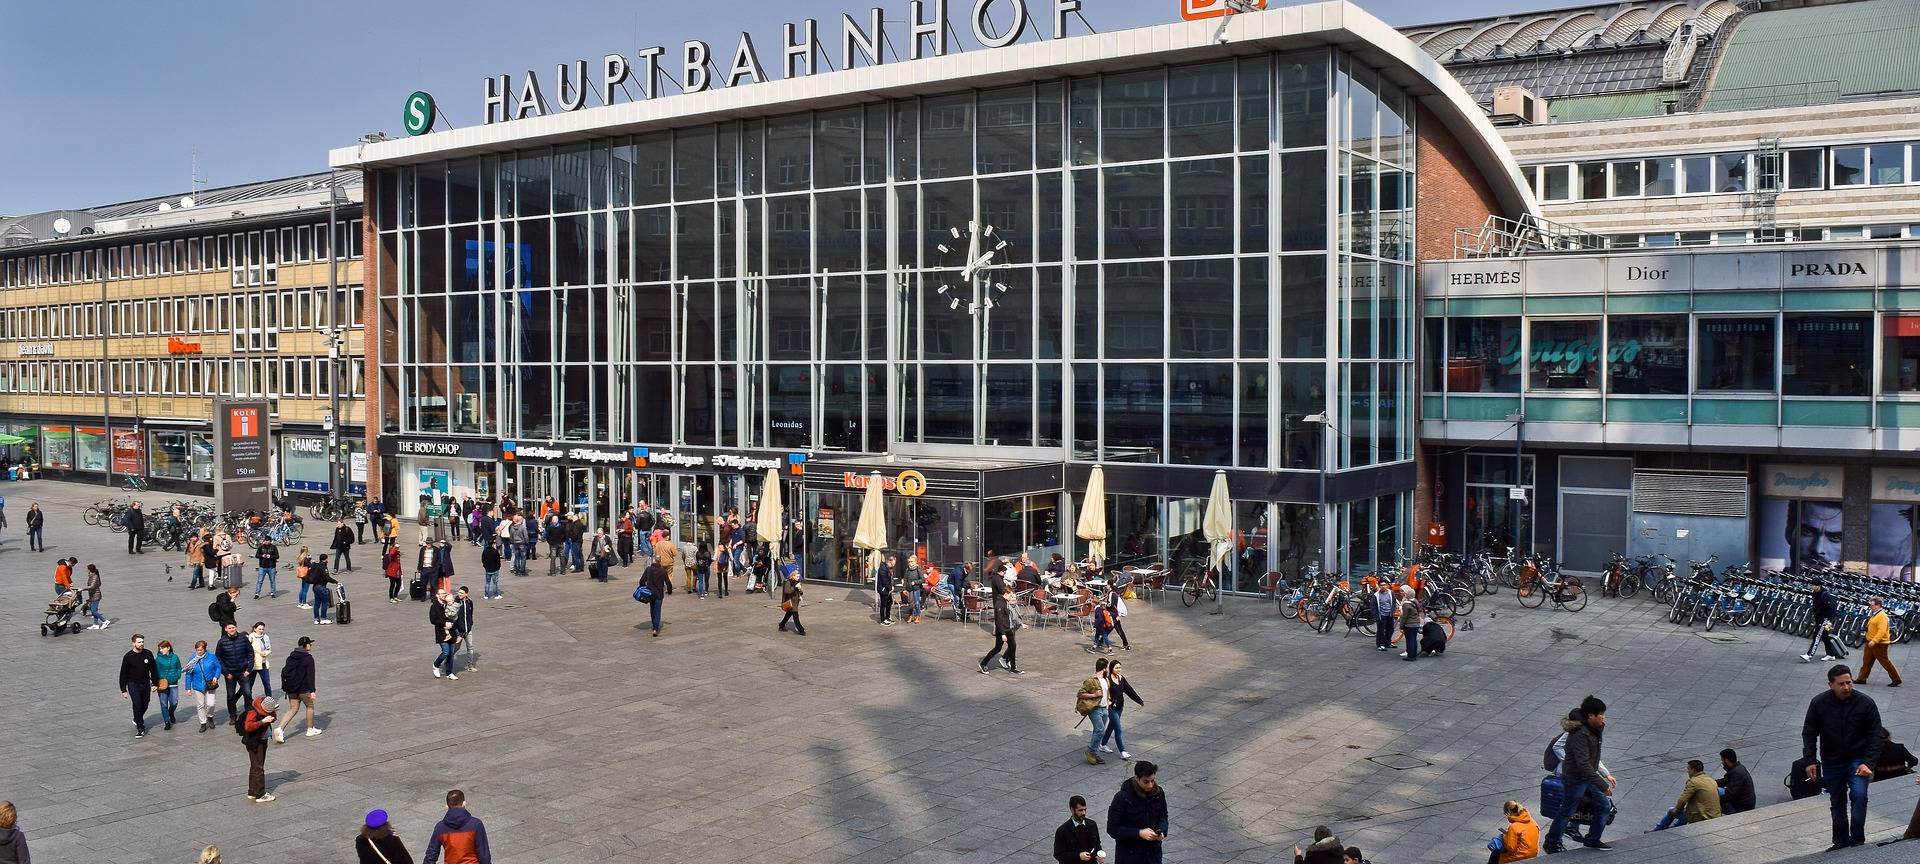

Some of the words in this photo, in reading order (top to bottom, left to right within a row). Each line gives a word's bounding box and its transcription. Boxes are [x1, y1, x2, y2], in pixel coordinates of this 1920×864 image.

[484, 0, 1081, 124] HAUPTBAHNHOF
[1627, 266, 1670, 281] Dior
[1791, 263, 1867, 276] PRADA
[1451, 271, 1521, 285] HERMÈS
[771, 420, 803, 429] Leonidas
[290, 438, 323, 452] CHANGE
[398, 441, 413, 452] THE
[414, 443, 437, 453] BODY
[437, 443, 460, 454] SHOP
